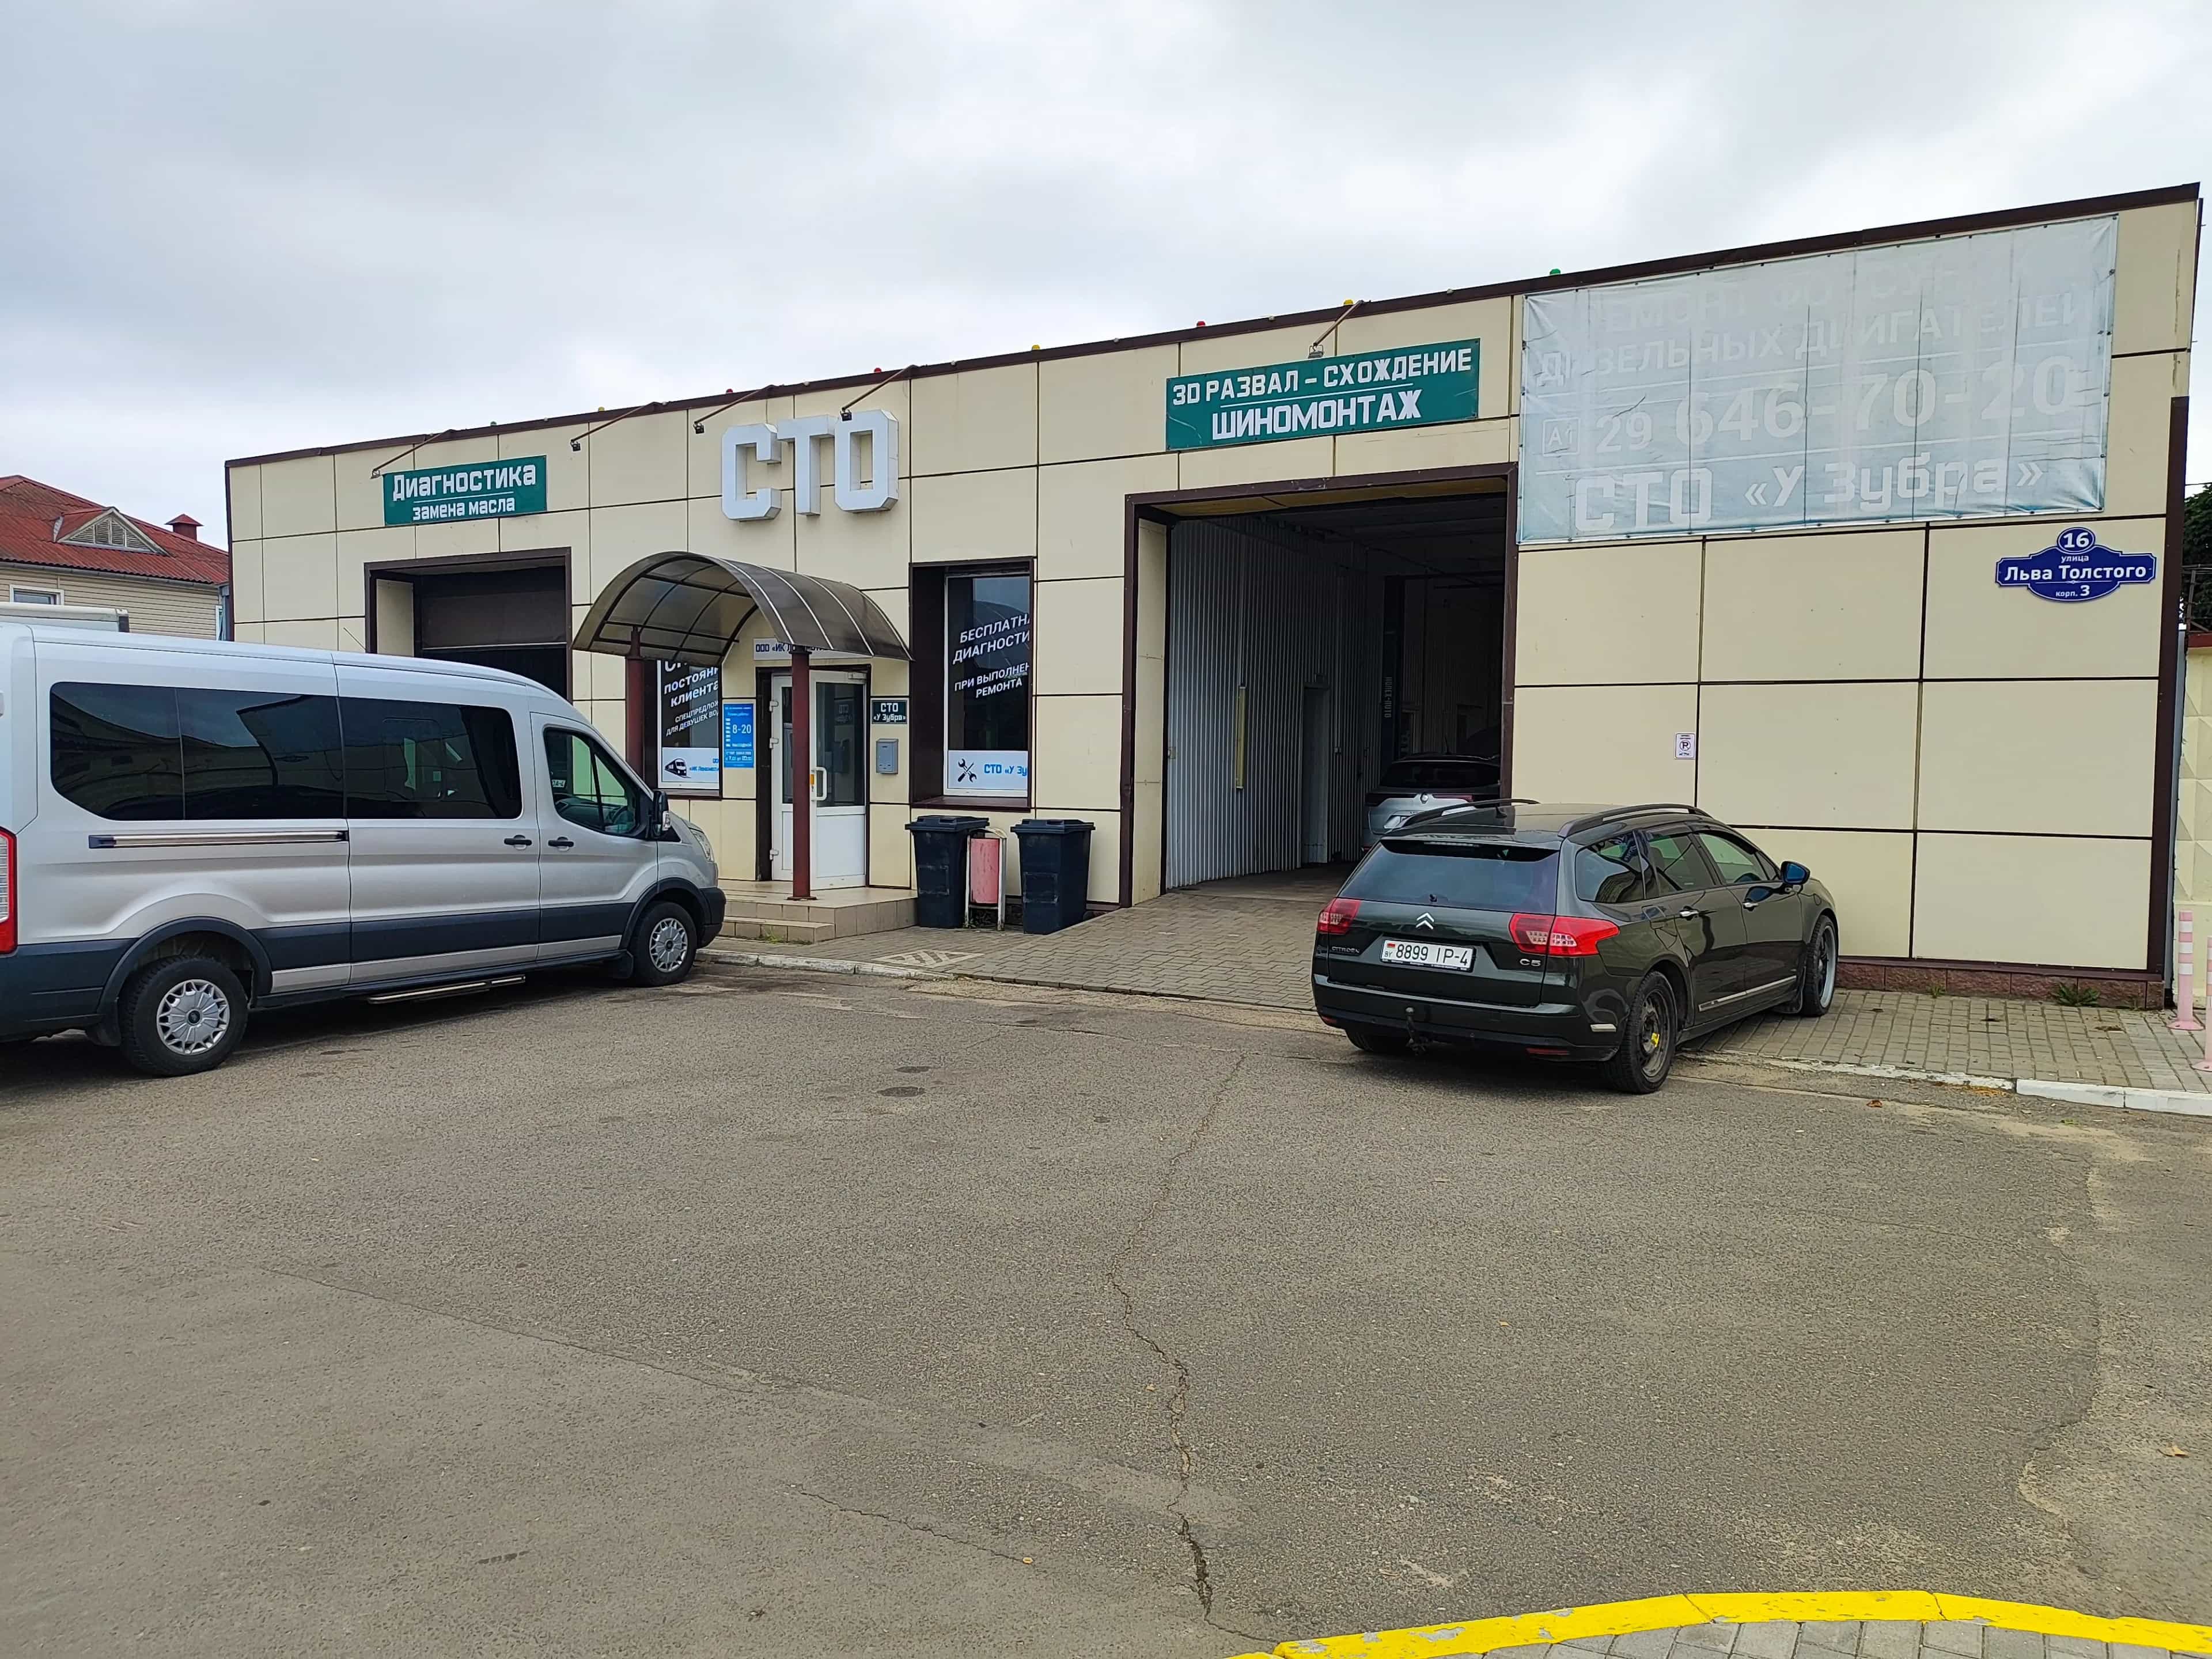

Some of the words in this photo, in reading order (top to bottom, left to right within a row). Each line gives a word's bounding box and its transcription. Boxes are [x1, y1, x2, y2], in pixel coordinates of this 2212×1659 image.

[1206, 370, 1298, 402] РАЗВАЛ
[1324, 348, 1472, 388] СХОЖДЕНИЕ
[1212, 389, 1422, 440] ШИНОМОНТАЖ
[1596, 411, 1653, 453] 29
[1676, 355, 2075, 446] 646-70-20
[722, 409, 899, 521] СТО
[393, 464, 536, 502] Диагностика
[412, 502, 465, 521] замена
[468, 497, 516, 516] масла
[1575, 467, 1713, 532] СТО
[2063, 532, 2089, 548] 16
[2061, 555, 2089, 563] улица
[2005, 566, 2052, 581] Льва
[2059, 565, 2146, 579] Толстого
[2080, 585, 2090, 597] 3
[960, 613, 1030, 643] БЕСПЛАТН
[756, 643, 770, 652] ООО
[954, 677, 975, 692] ПРИ
[975, 677, 1022, 699] РЕМОНТА
[880, 702, 899, 713] СТО
[666, 725, 679, 737] ДЛЯ
[679, 713, 709, 732] ДЕВУШЕК
[732, 724, 752, 734] 8-20
[984, 764, 1002, 774] СТО
[1396, 944, 1429, 961] 8899
[1436, 948, 1468, 966] IP-4
[1520, 959, 1541, 967] C5
